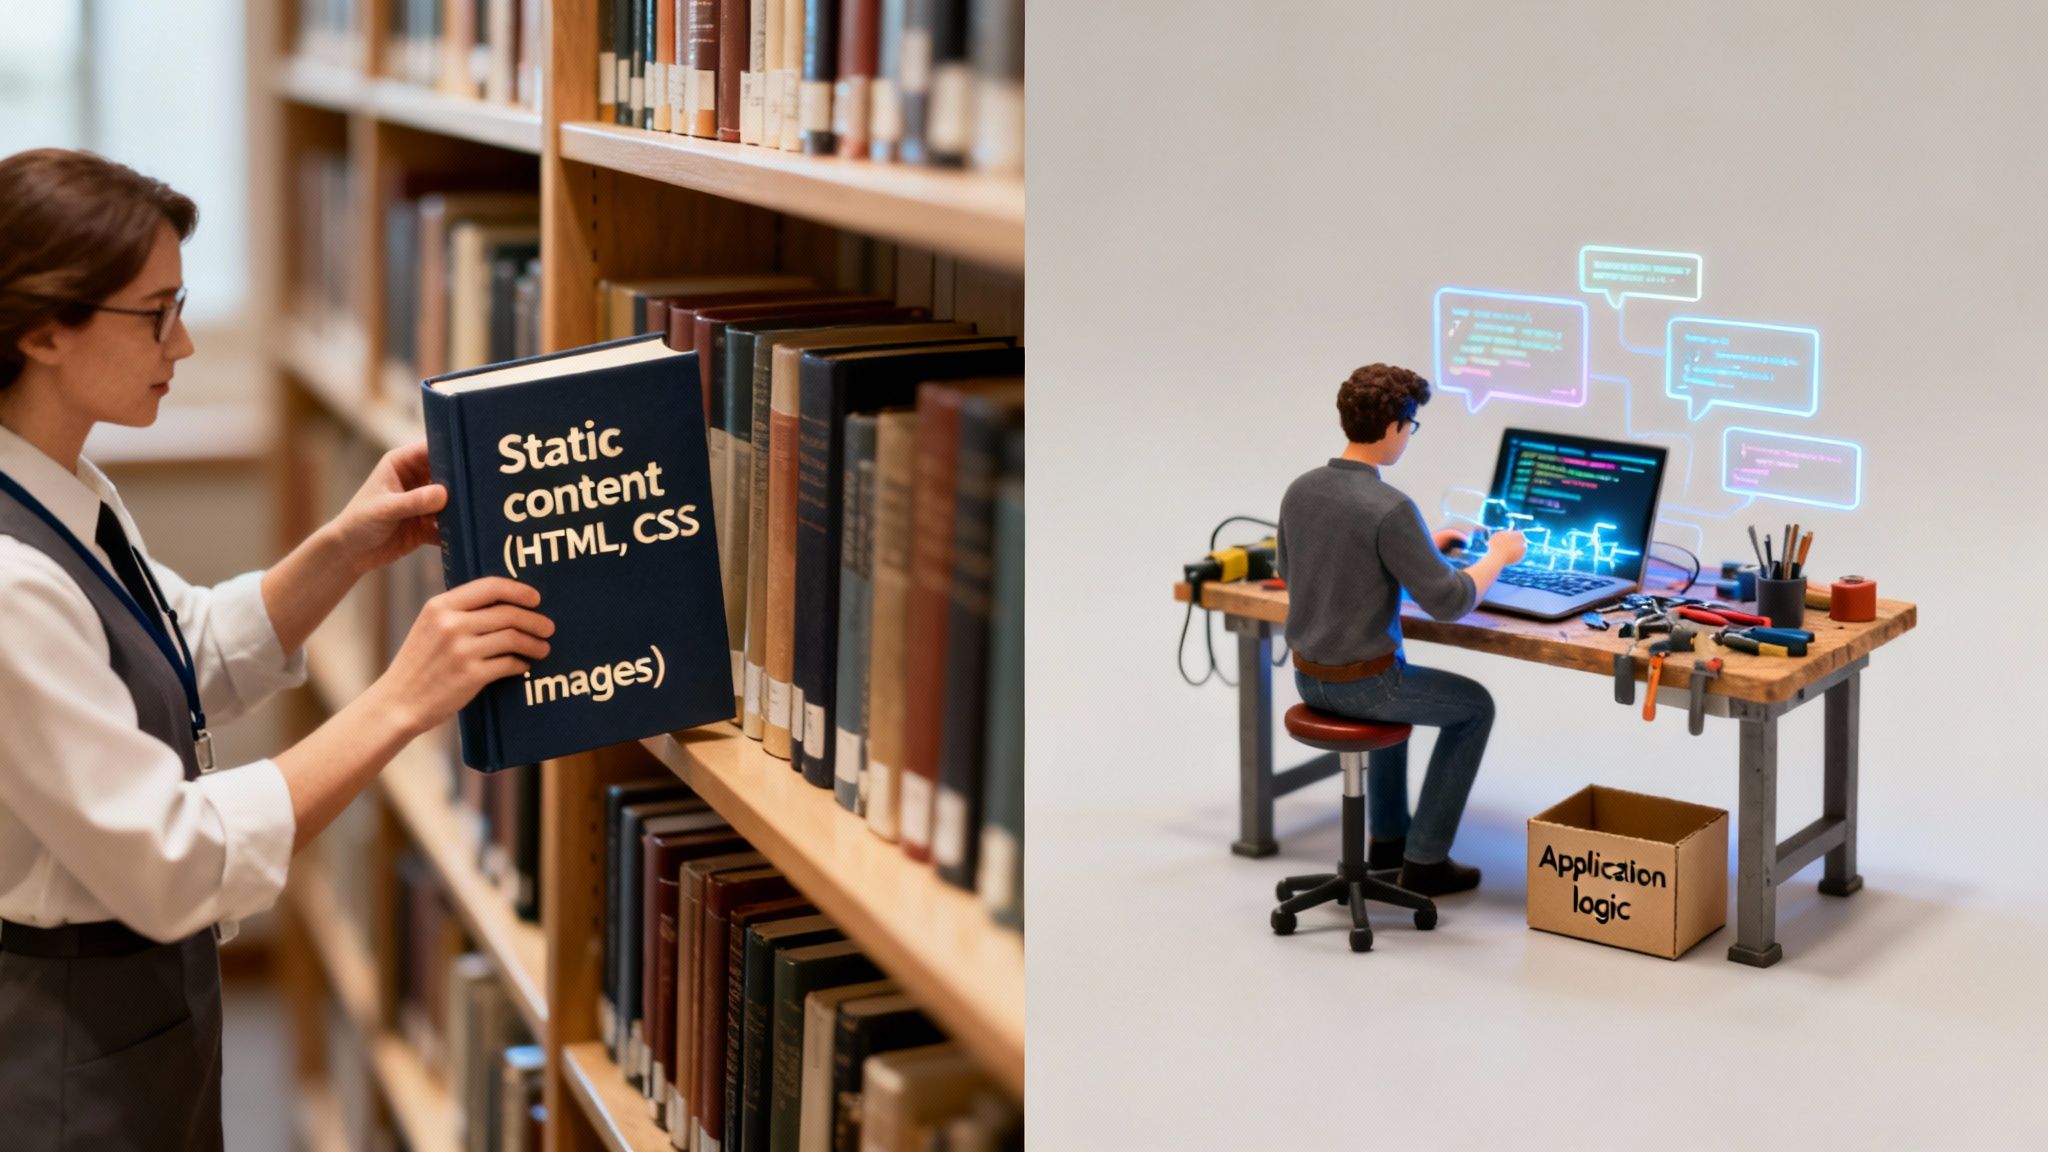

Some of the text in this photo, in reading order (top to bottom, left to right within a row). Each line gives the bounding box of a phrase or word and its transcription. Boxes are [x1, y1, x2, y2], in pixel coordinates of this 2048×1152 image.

[498, 420, 623, 474] Static
[503, 462, 666, 522] content
[503, 522, 628, 578] (HTML,
[633, 505, 700, 544] CSS
[524, 645, 666, 706] images)
[1573, 885, 1631, 924] logic
